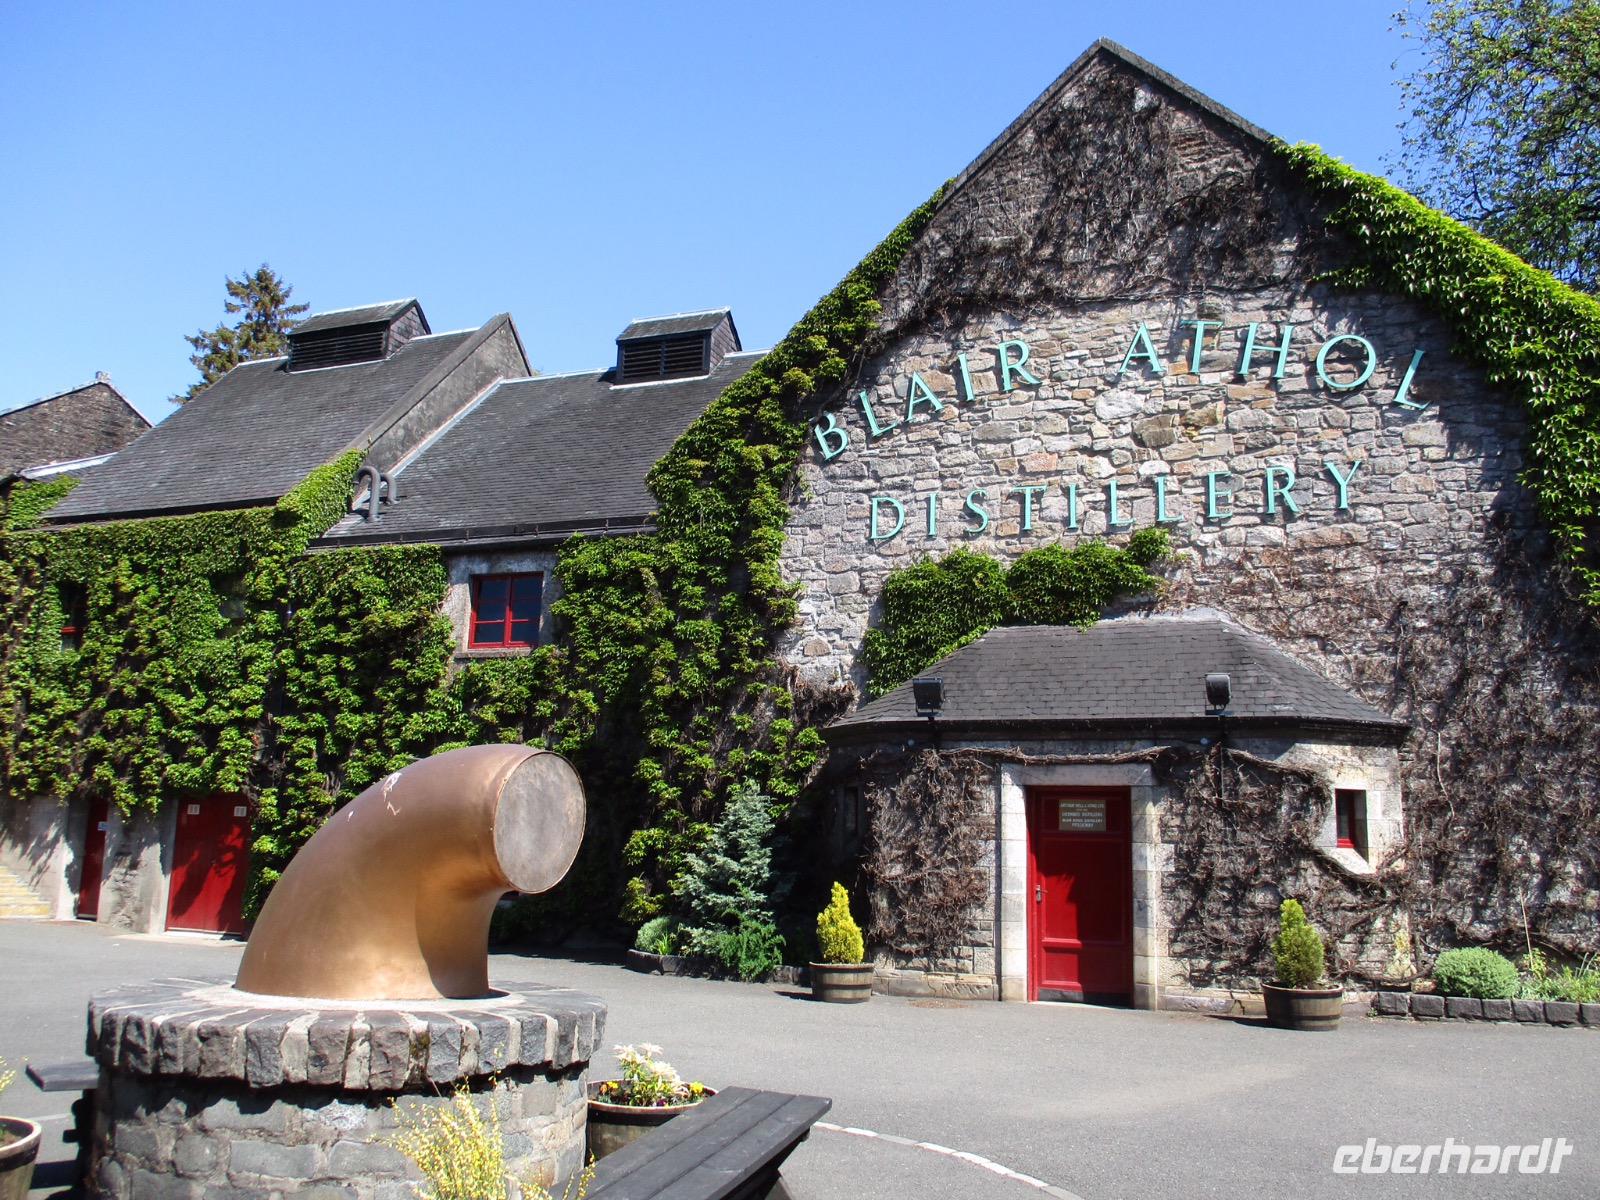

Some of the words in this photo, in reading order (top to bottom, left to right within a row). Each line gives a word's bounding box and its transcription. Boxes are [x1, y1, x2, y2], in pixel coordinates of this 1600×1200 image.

[814, 339, 1042, 461] BLAIR
[1118, 320, 1430, 410] ATHOL
[869, 460, 1361, 540] DISTILLERY
